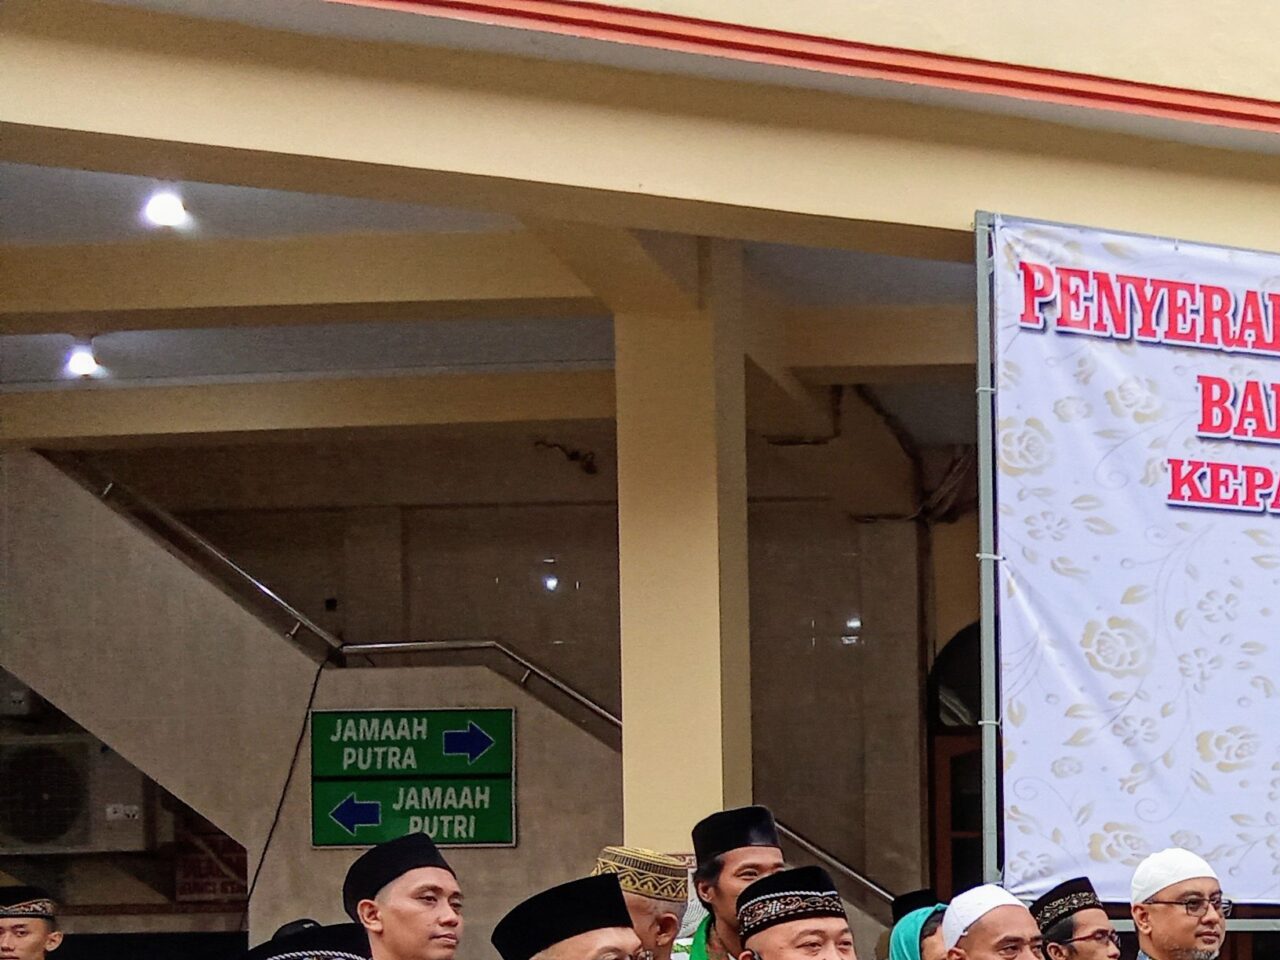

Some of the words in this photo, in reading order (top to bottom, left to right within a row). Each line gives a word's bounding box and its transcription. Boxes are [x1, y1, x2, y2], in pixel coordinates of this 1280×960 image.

[330, 717, 428, 742] JAMAAH
[342, 746, 418, 771] PUTRA
[392, 786, 491, 811] JAMAAH
[408, 814, 476, 839] PUTRI
